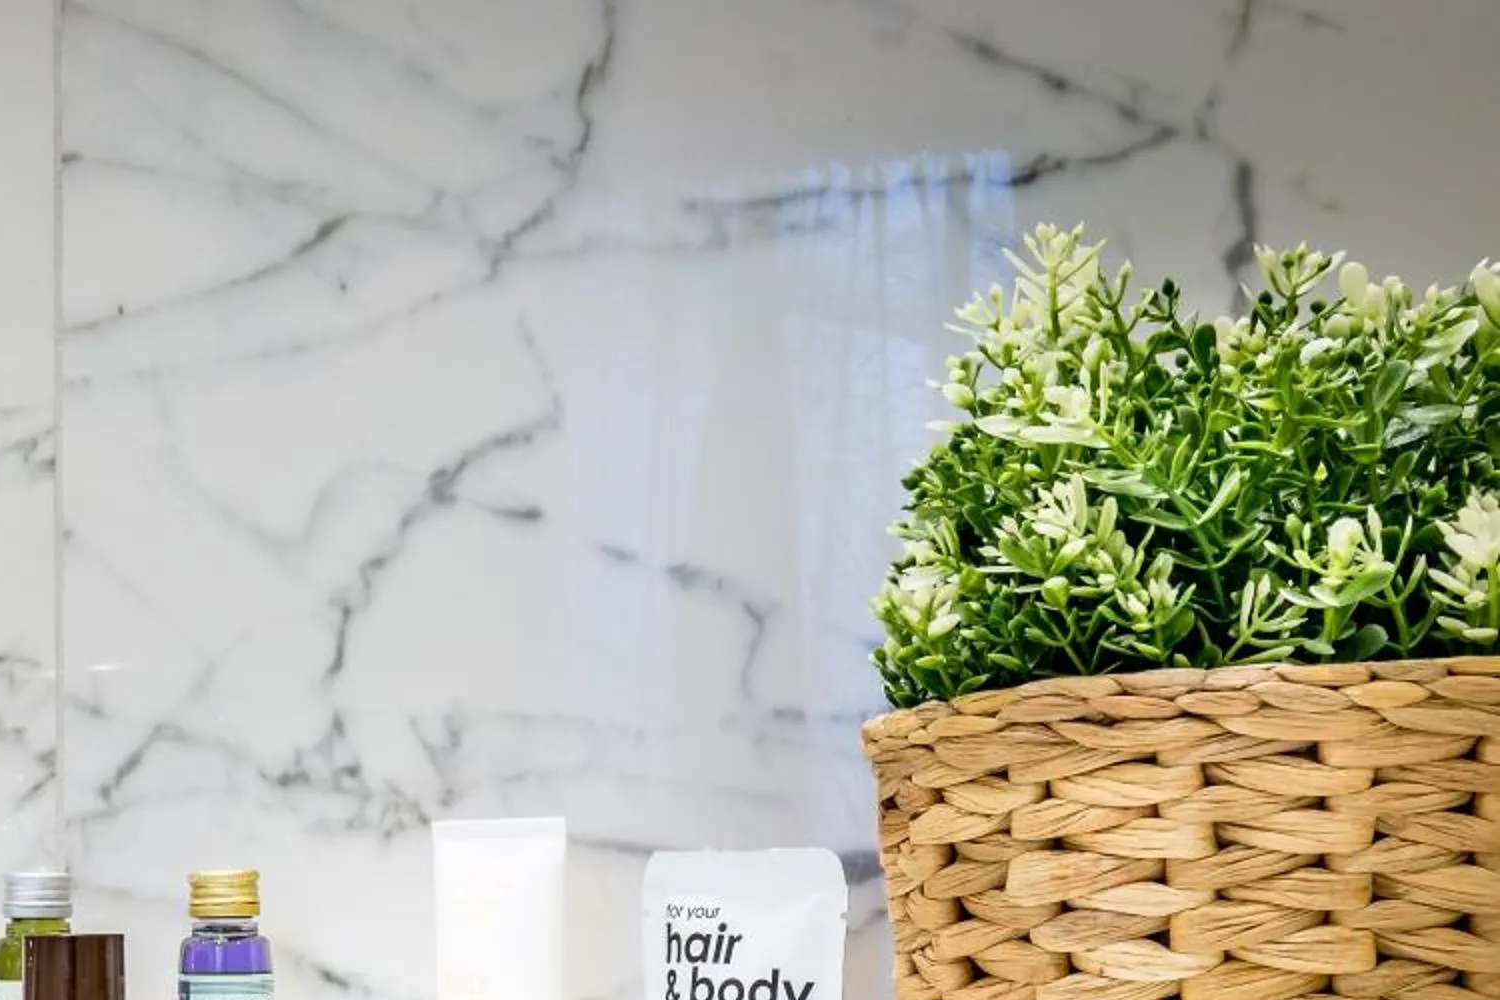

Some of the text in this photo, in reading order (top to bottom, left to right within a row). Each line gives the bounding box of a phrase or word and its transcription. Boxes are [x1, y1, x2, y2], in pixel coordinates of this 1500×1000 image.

[665, 903, 721, 920] for your
[665, 921, 743, 965] hair
